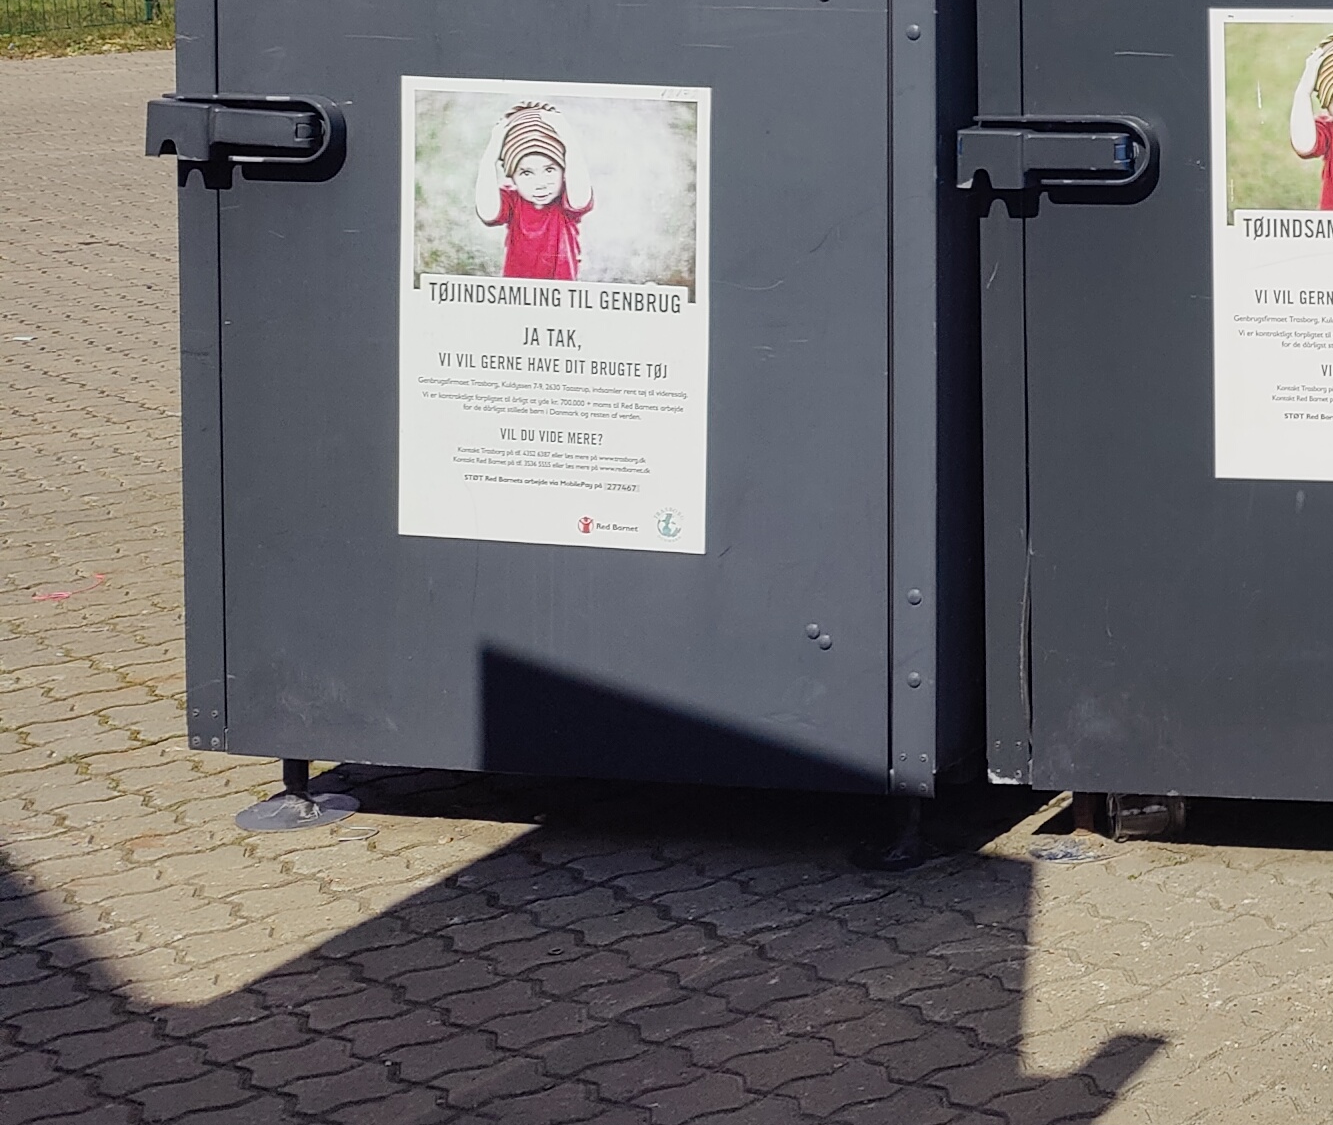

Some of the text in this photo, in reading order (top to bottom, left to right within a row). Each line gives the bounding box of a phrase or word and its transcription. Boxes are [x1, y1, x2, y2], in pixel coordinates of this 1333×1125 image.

[429, 281, 681, 313] TØJINDSAMLING TIL GENBRUG
[1254, 289, 1268, 304] VI
[1273, 289, 1294, 305] VIL
[522, 327, 581, 351] JA TAK,
[438, 352, 667, 380] VI VIL GERNE HAVE DIT BRUGTE TØJ
[499, 427, 603, 446] VIL DU VIDE MERE?
[595, 522, 638, 532] Red Barnet
